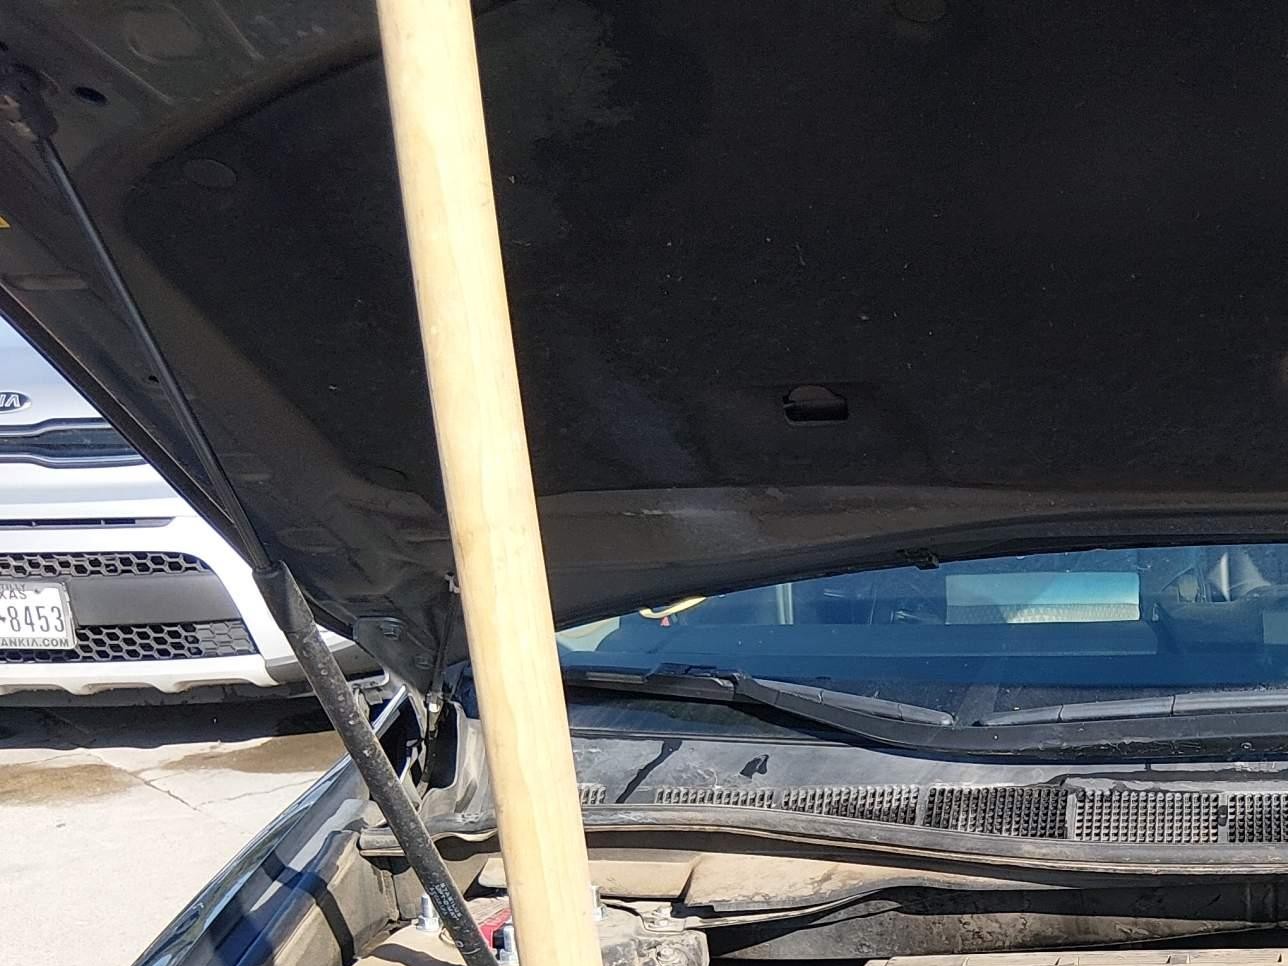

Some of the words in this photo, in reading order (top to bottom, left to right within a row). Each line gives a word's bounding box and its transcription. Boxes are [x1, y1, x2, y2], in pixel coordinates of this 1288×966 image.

[0, 394, 21, 408] IA
[0, 590, 28, 600] XAS
[0, 638, 70, 648] ANKIA.COM
